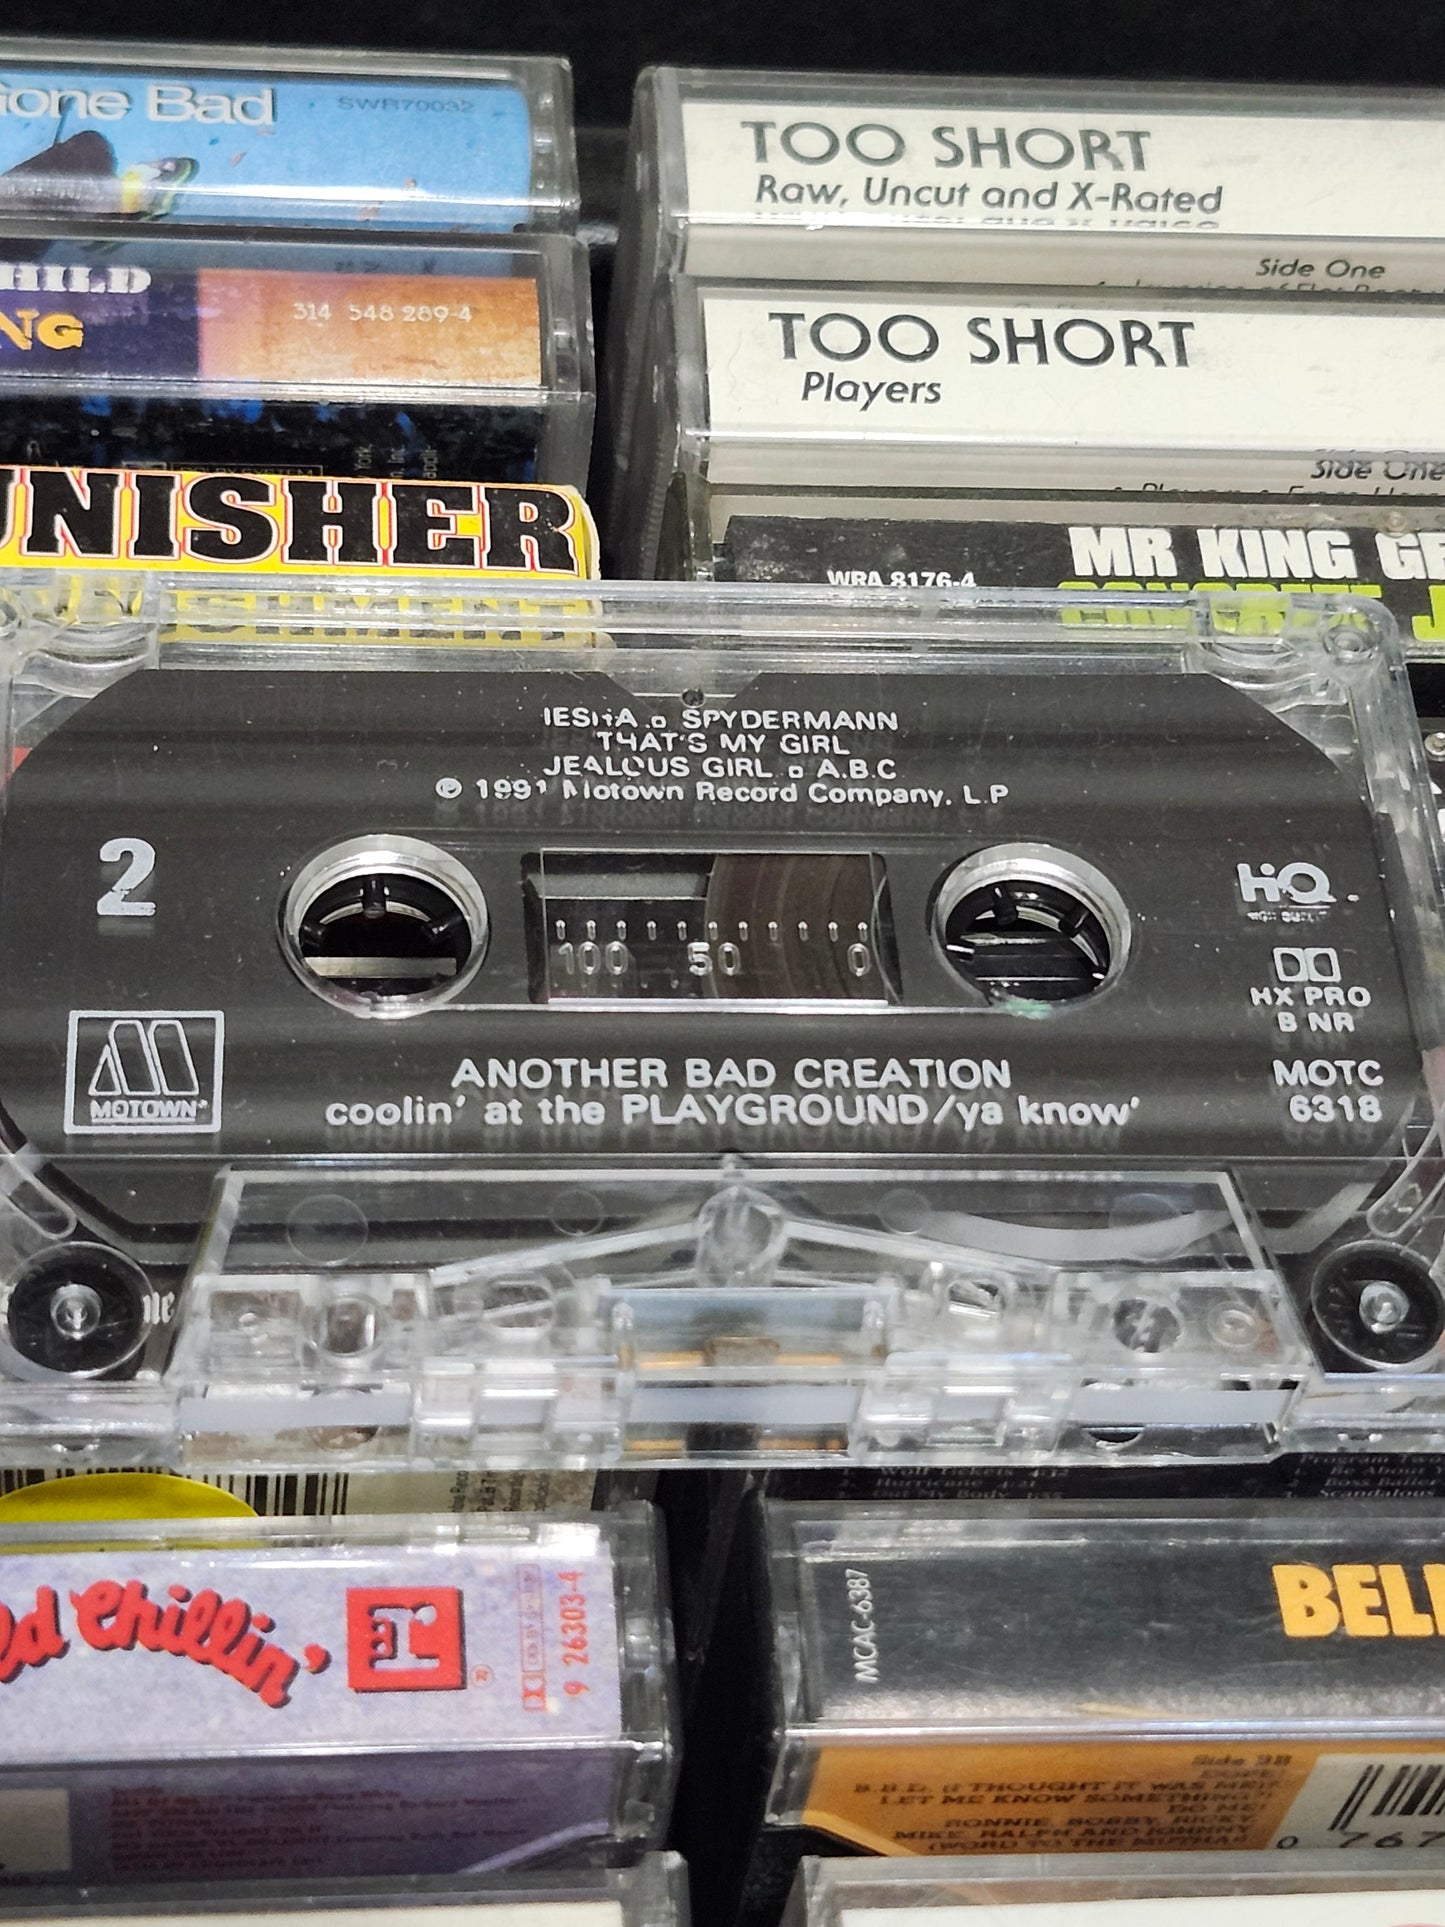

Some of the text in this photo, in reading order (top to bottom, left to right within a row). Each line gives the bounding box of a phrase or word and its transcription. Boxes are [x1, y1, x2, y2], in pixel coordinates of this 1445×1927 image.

[0, 82, 276, 126] one Bad
[337, 97, 474, 114] SWR70032
[742, 121, 1152, 173] TOO SHORT
[755, 174, 1223, 215] Raw, Uncut and X-Rated
[1256, 258, 1386, 280] Side One
[293, 303, 472, 323] 314 548 289-4
[769, 312, 1195, 368] TOO SHORT
[801, 371, 942, 411] Players
[1310, 458, 1445, 481] Side One
[1067, 526, 1178, 577] MR
[1196, 529, 1358, 579] KING
[826, 570, 977, 588] WRA 8176-4
[682, 709, 899, 732] SPYDERMANN
[597, 731, 851, 756] THAT'S MY GIRL
[543, 756, 898, 781] JEALOUS GIRL A.B.C
[476, 779, 548, 799] 1991
[563, 780, 684, 802] Motown
[697, 781, 798, 803] Record
[97, 837, 157, 918] 2
[688, 942, 737, 977] 50
[1250, 985, 1372, 1008] HX PRO
[1278, 1012, 1355, 1033] B NR
[452, 1058, 1011, 1090] ANOTHER BAD CREATION
[1273, 1060, 1385, 1087] MOTC
[90, 1099, 198, 1122] MOTOWN
[325, 1093, 466, 1125] coolin'
[484, 1097, 523, 1126] at
[537, 1095, 606, 1125] the
[1019, 1096, 1141, 1126] know'
[1289, 1094, 1383, 1123] 6318
[557, 1570, 591, 1666] 26303-4
[845, 1568, 880, 1684] MCAC-6387
[562, 1680, 591, 1696] 9
[969, 1780, 1107, 1793] THOUGHT
[1113, 1780, 1138, 1791] IT
[1151, 1779, 1207, 1791] WAS
[880, 1794, 934, 1805] LET
[942, 1794, 985, 1805] ME
[991, 1793, 1078, 1805] KNOW
[1079, 1827, 1140, 1838] AND
